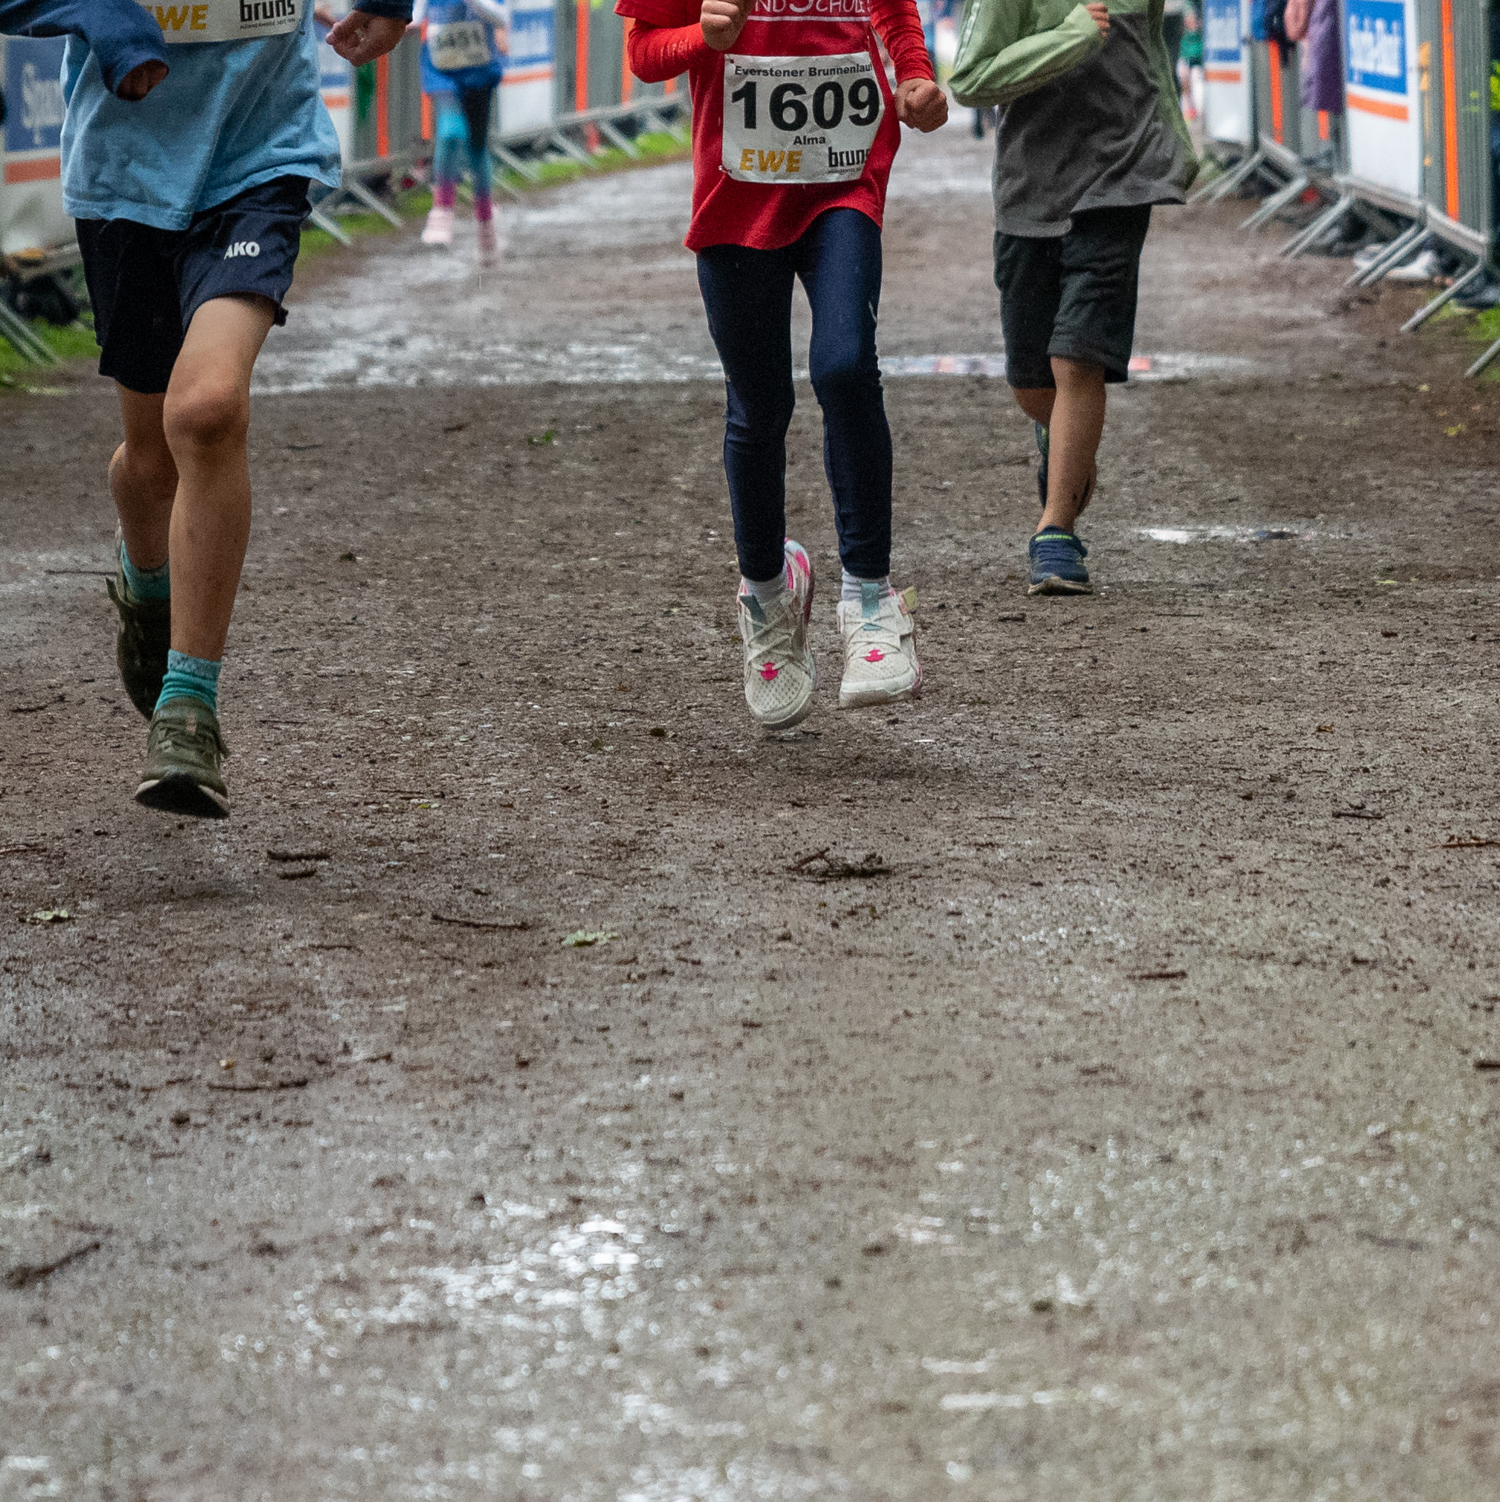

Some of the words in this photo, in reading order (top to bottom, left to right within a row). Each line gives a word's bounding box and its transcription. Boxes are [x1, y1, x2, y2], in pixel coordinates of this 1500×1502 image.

[149, 4, 209, 31] WE
[734, 65, 805, 77] Everstener
[731, 77, 880, 132] 1609
[793, 135, 826, 146] Alma
[739, 148, 802, 173] EWE
[223, 241, 260, 261] AKO
